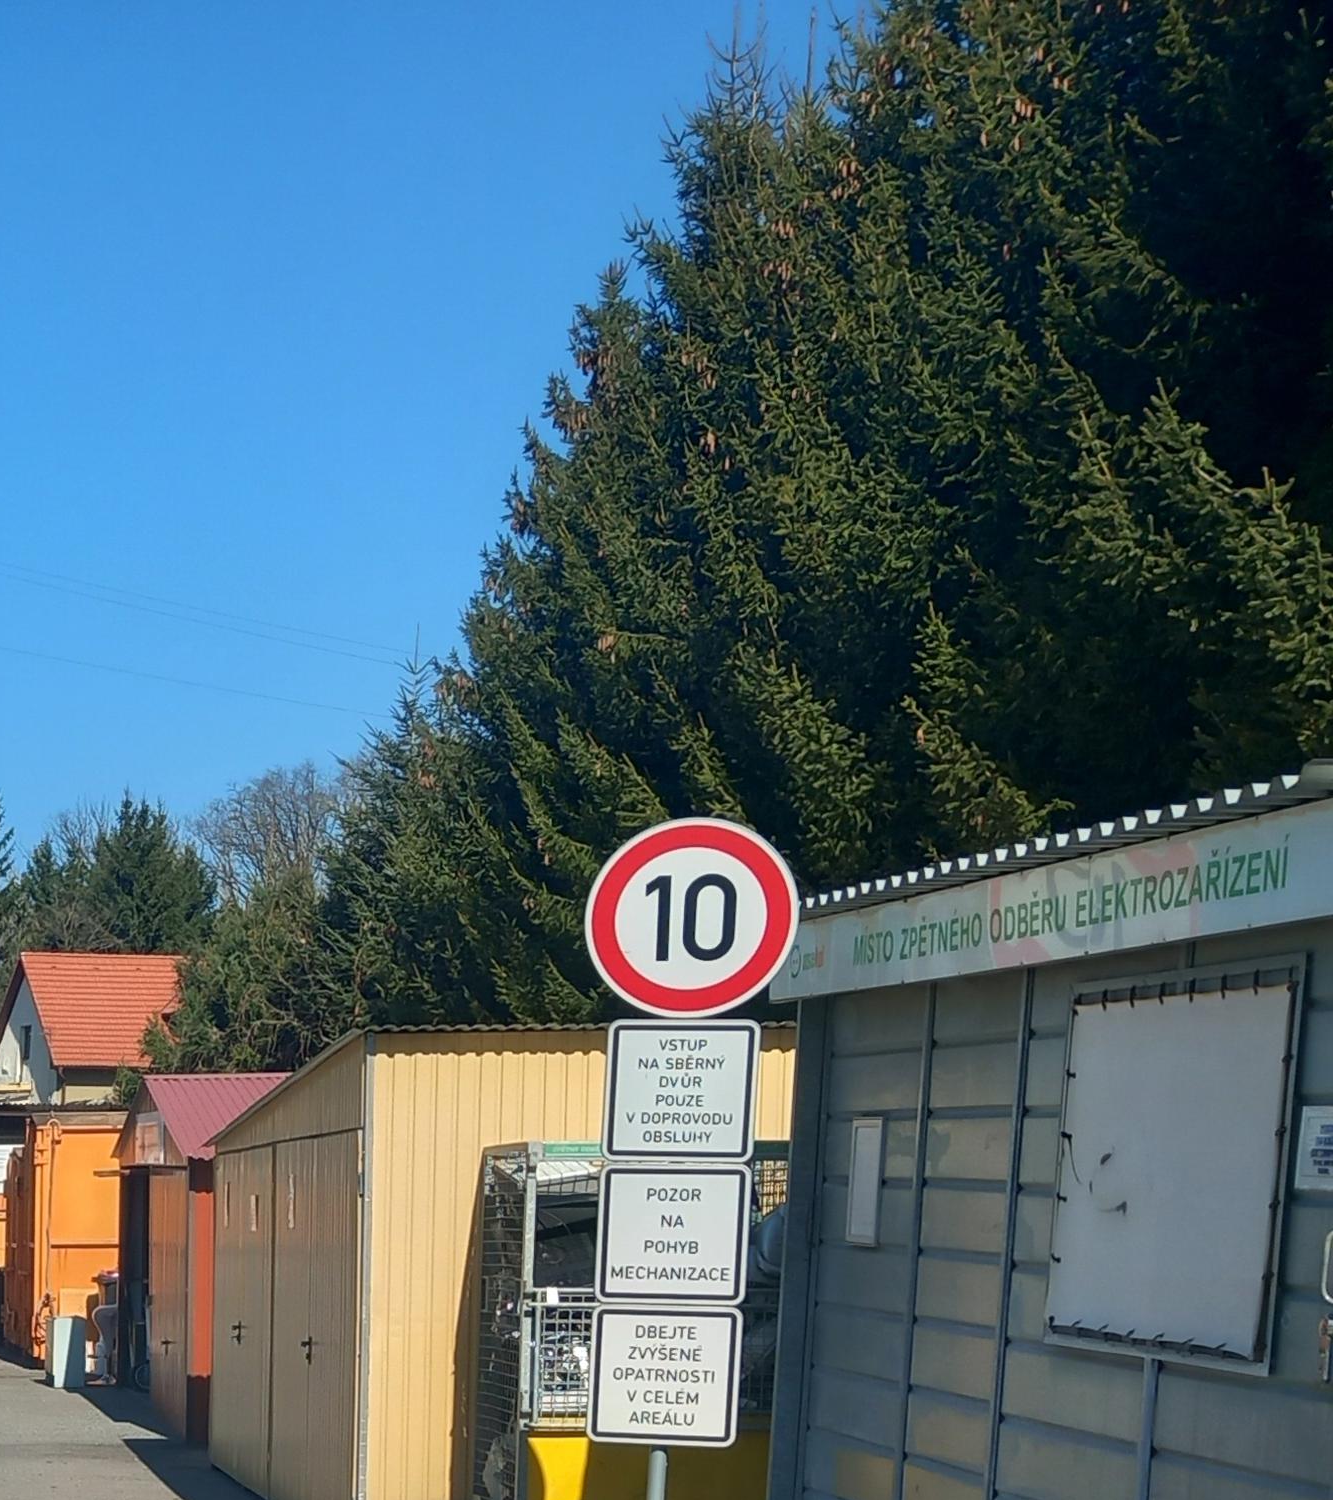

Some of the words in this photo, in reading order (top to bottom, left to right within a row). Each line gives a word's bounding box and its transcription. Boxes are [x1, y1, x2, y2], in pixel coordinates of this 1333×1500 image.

[853, 926, 894, 966] MÍSTO
[899, 908, 982, 960] ZPĚTNÉHO
[990, 892, 1067, 943] ODBĚRU
[1075, 833, 1290, 928] ELEKTROZAŘÍZENÍ
[645, 873, 737, 962] 10
[659, 1039, 707, 1051] VSTUP
[638, 1058, 659, 1069] NA
[665, 1055, 725, 1069] SBĚRNÝ
[659, 1073, 702, 1088] DVŮR
[655, 1094, 704, 1107] POUZE
[626, 1112, 635, 1123] V
[641, 1112, 733, 1125] DOPROVODU
[643, 1130, 712, 1143] OBSLUHY
[646, 1188, 701, 1201] POZOR
[661, 1215, 684, 1228] NA
[644, 1240, 699, 1254] POHYB
[611, 1266, 730, 1281] MECHANIZACE
[635, 1325, 697, 1340] DBEJTE
[628, 1344, 702, 1362] ZVÝŠENÉ
[613, 1367, 715, 1384] OPATRNOSTI
[627, 1390, 637, 1402] V
[643, 1388, 699, 1405] CELÉM
[629, 1409, 695, 1426] AREÁLU
